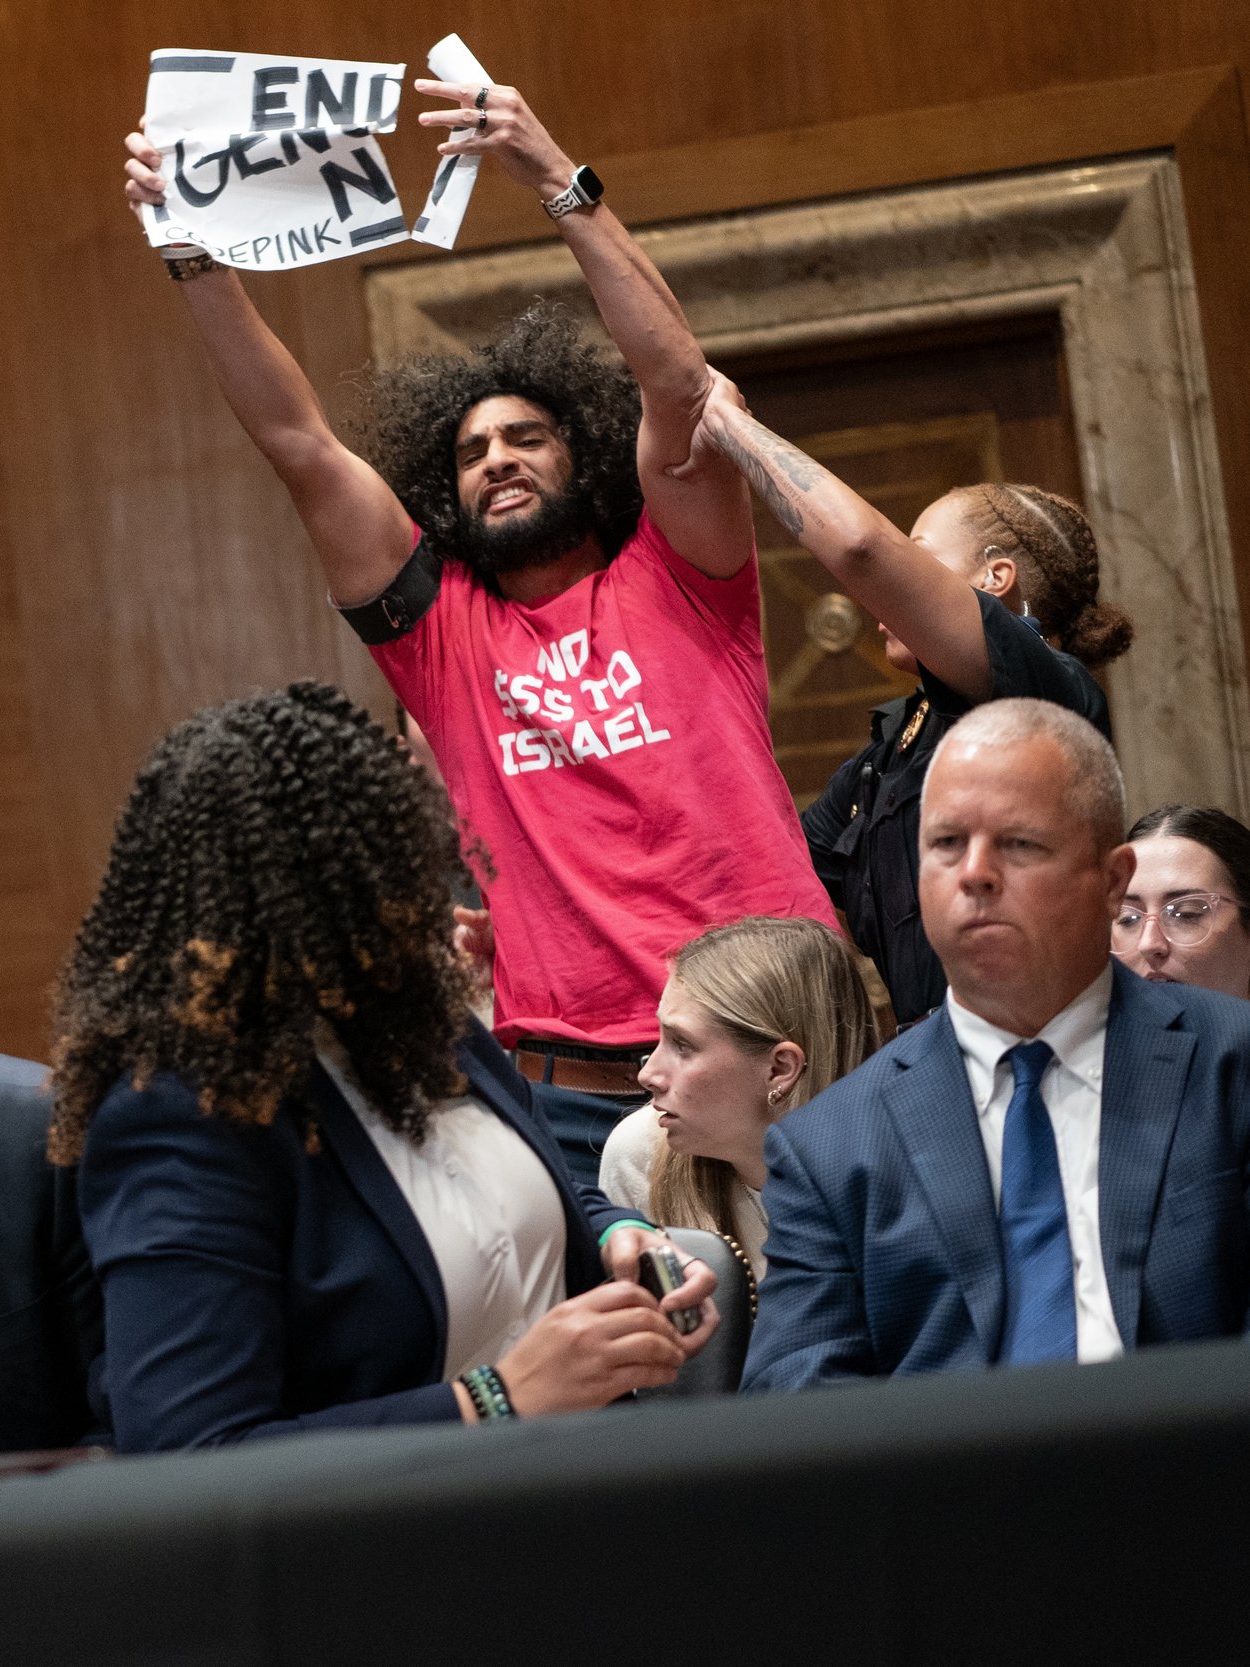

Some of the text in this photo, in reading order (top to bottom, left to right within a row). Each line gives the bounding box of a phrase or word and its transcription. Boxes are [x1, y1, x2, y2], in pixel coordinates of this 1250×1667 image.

[175, 127, 369, 208] GEN
[537, 628, 589, 682] NO
[580, 650, 642, 712] TO
[498, 702, 671, 776] ISRAEL
